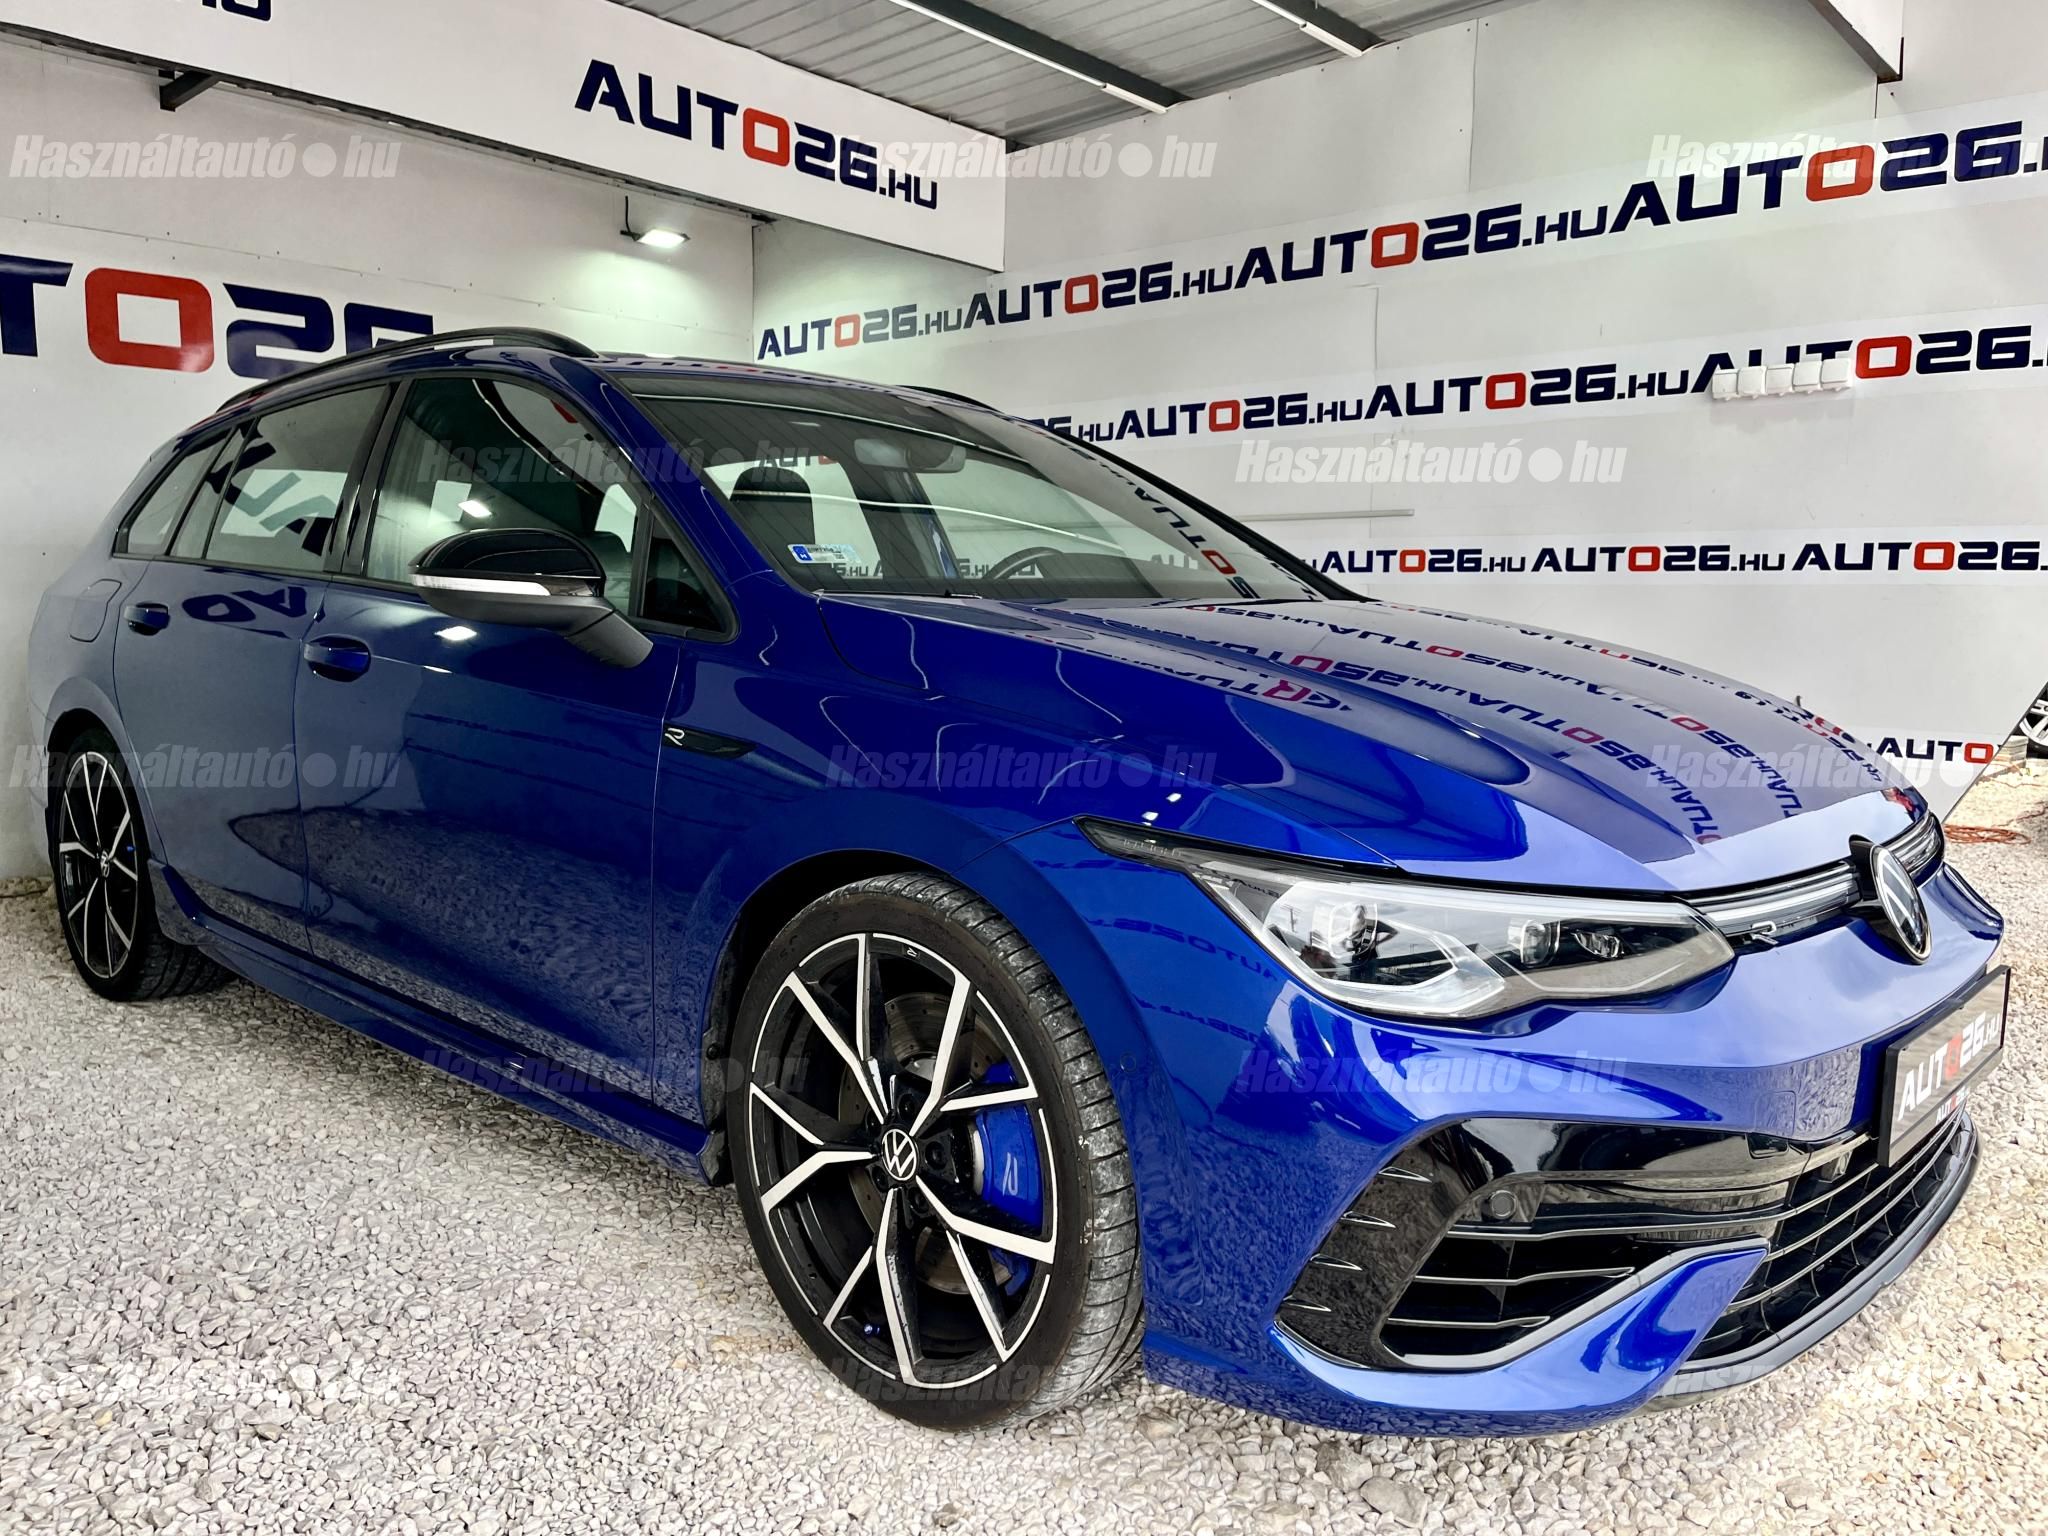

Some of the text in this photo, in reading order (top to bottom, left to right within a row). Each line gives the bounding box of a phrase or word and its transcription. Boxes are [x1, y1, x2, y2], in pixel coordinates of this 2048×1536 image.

[574, 59, 938, 210] AUTO26.HU
[1609, 120, 2048, 234] AUTO26.
[1234, 203, 1607, 290] AUTO26.HU
[963, 261, 1234, 329] AUTO26.HU
[757, 303, 963, 361] AUTO26.HU
[1115, 392, 1363, 440] AUTO26.HU
[1364, 364, 1689, 420] AUTO26.HU
[1321, 548, 1525, 574] AUTO26.HU
[1531, 544, 1786, 573] AUTO26.HU
[1873, 736, 2004, 765] AUTO
